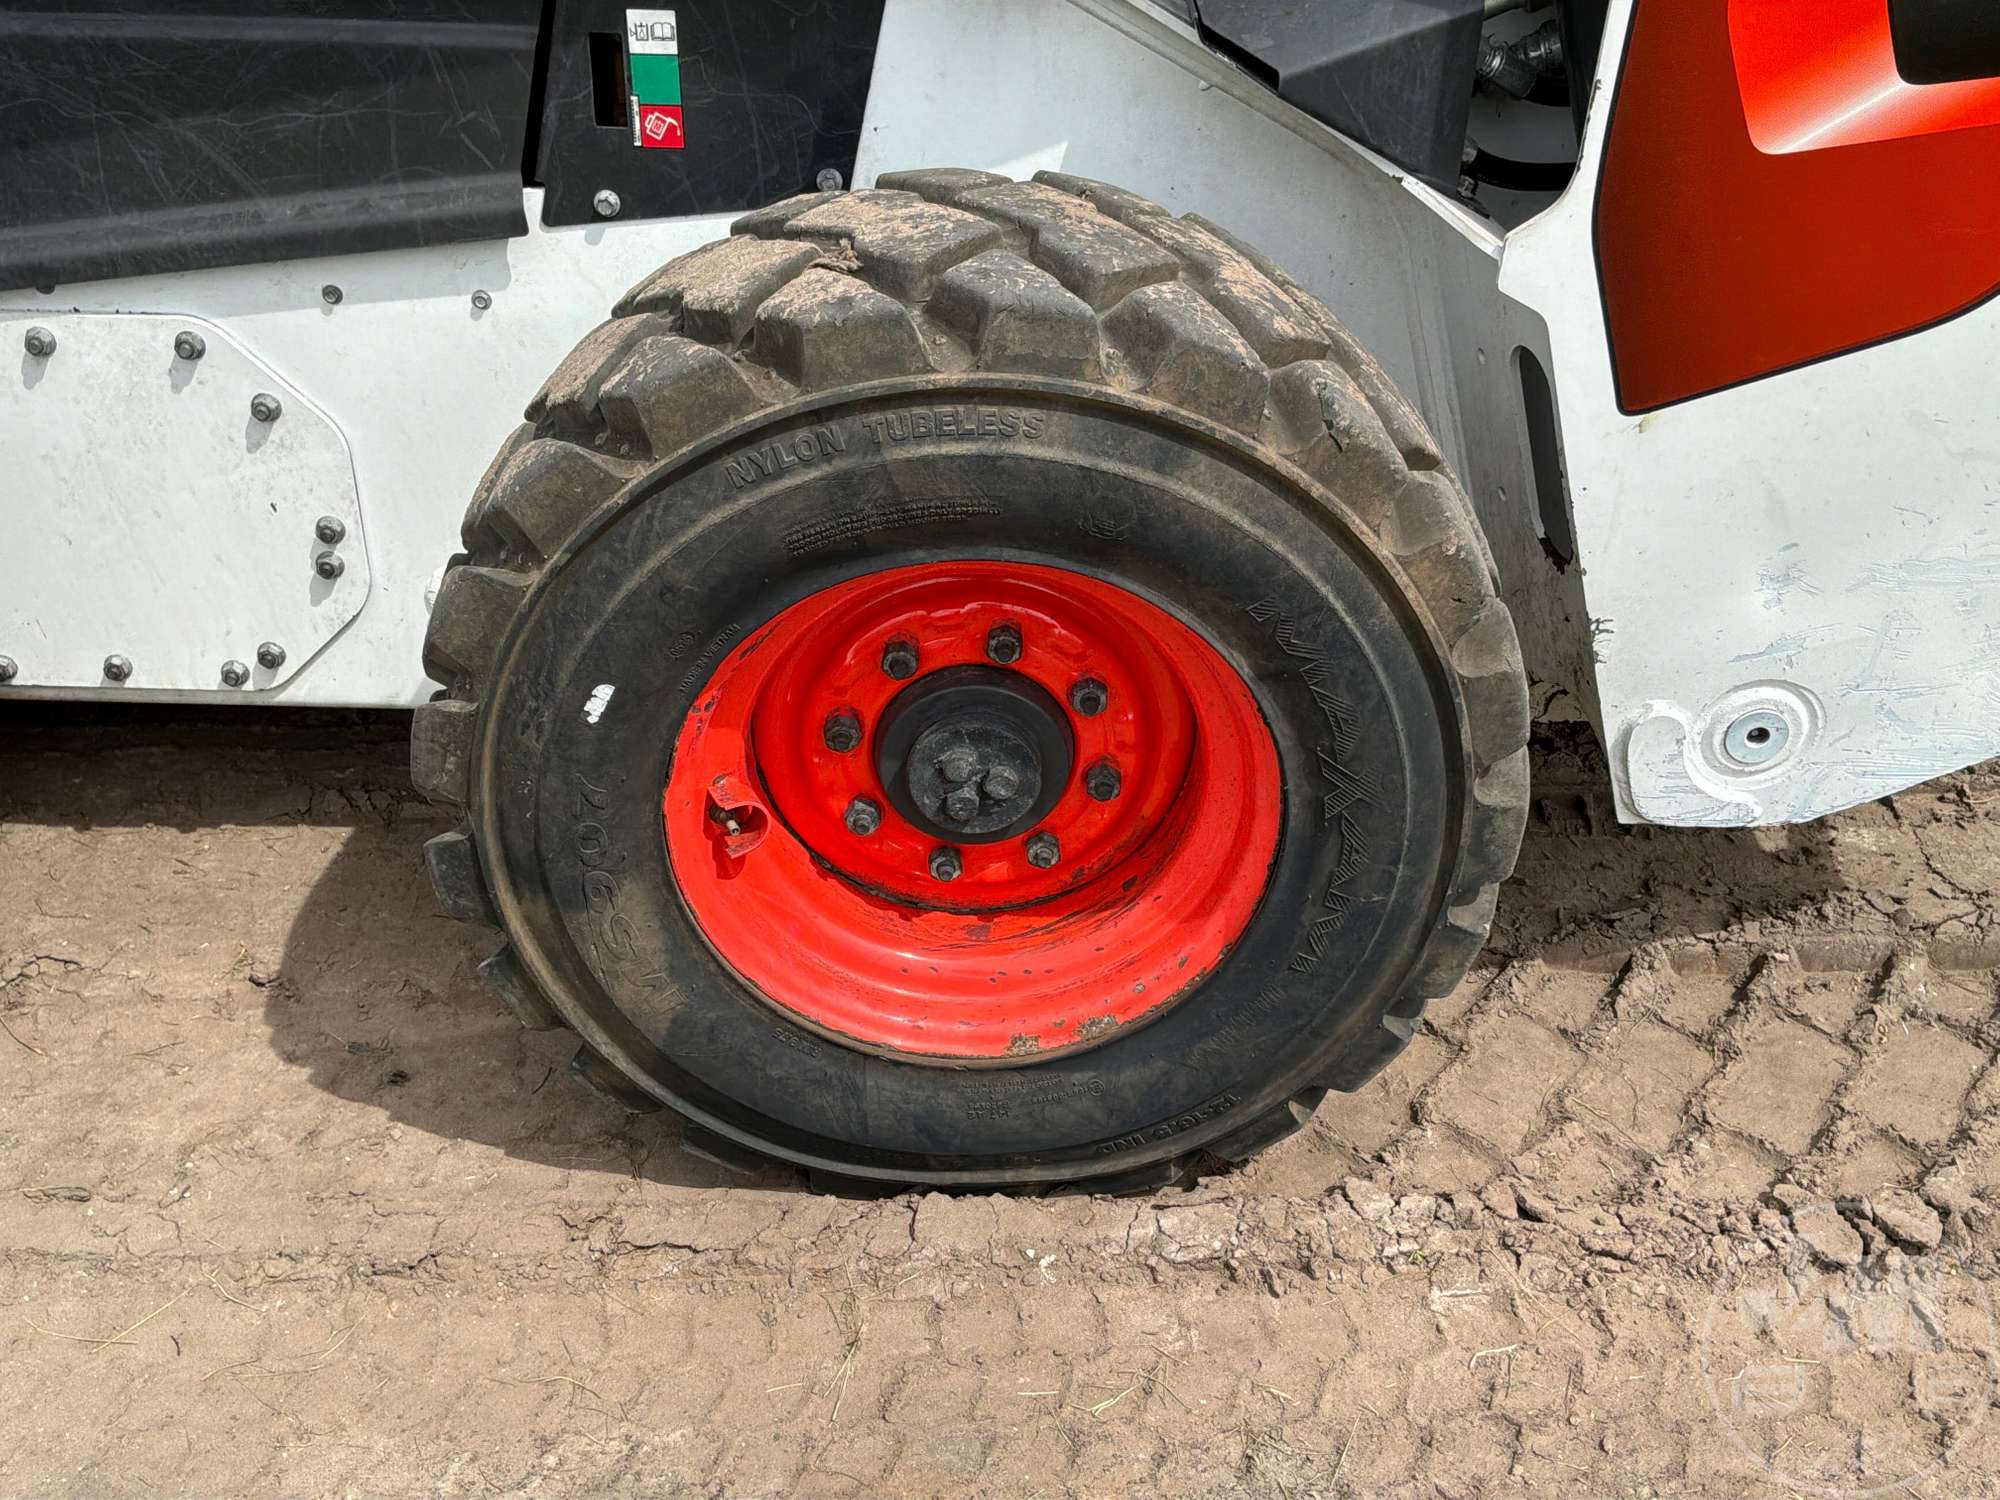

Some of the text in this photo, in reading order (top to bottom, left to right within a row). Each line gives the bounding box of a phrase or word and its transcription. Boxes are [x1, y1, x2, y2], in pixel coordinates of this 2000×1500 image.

[725, 408, 1044, 489] NYLON TUBELESS
[575, 773, 688, 1012] MS907
[1246, 597, 1380, 974] MAXAM
